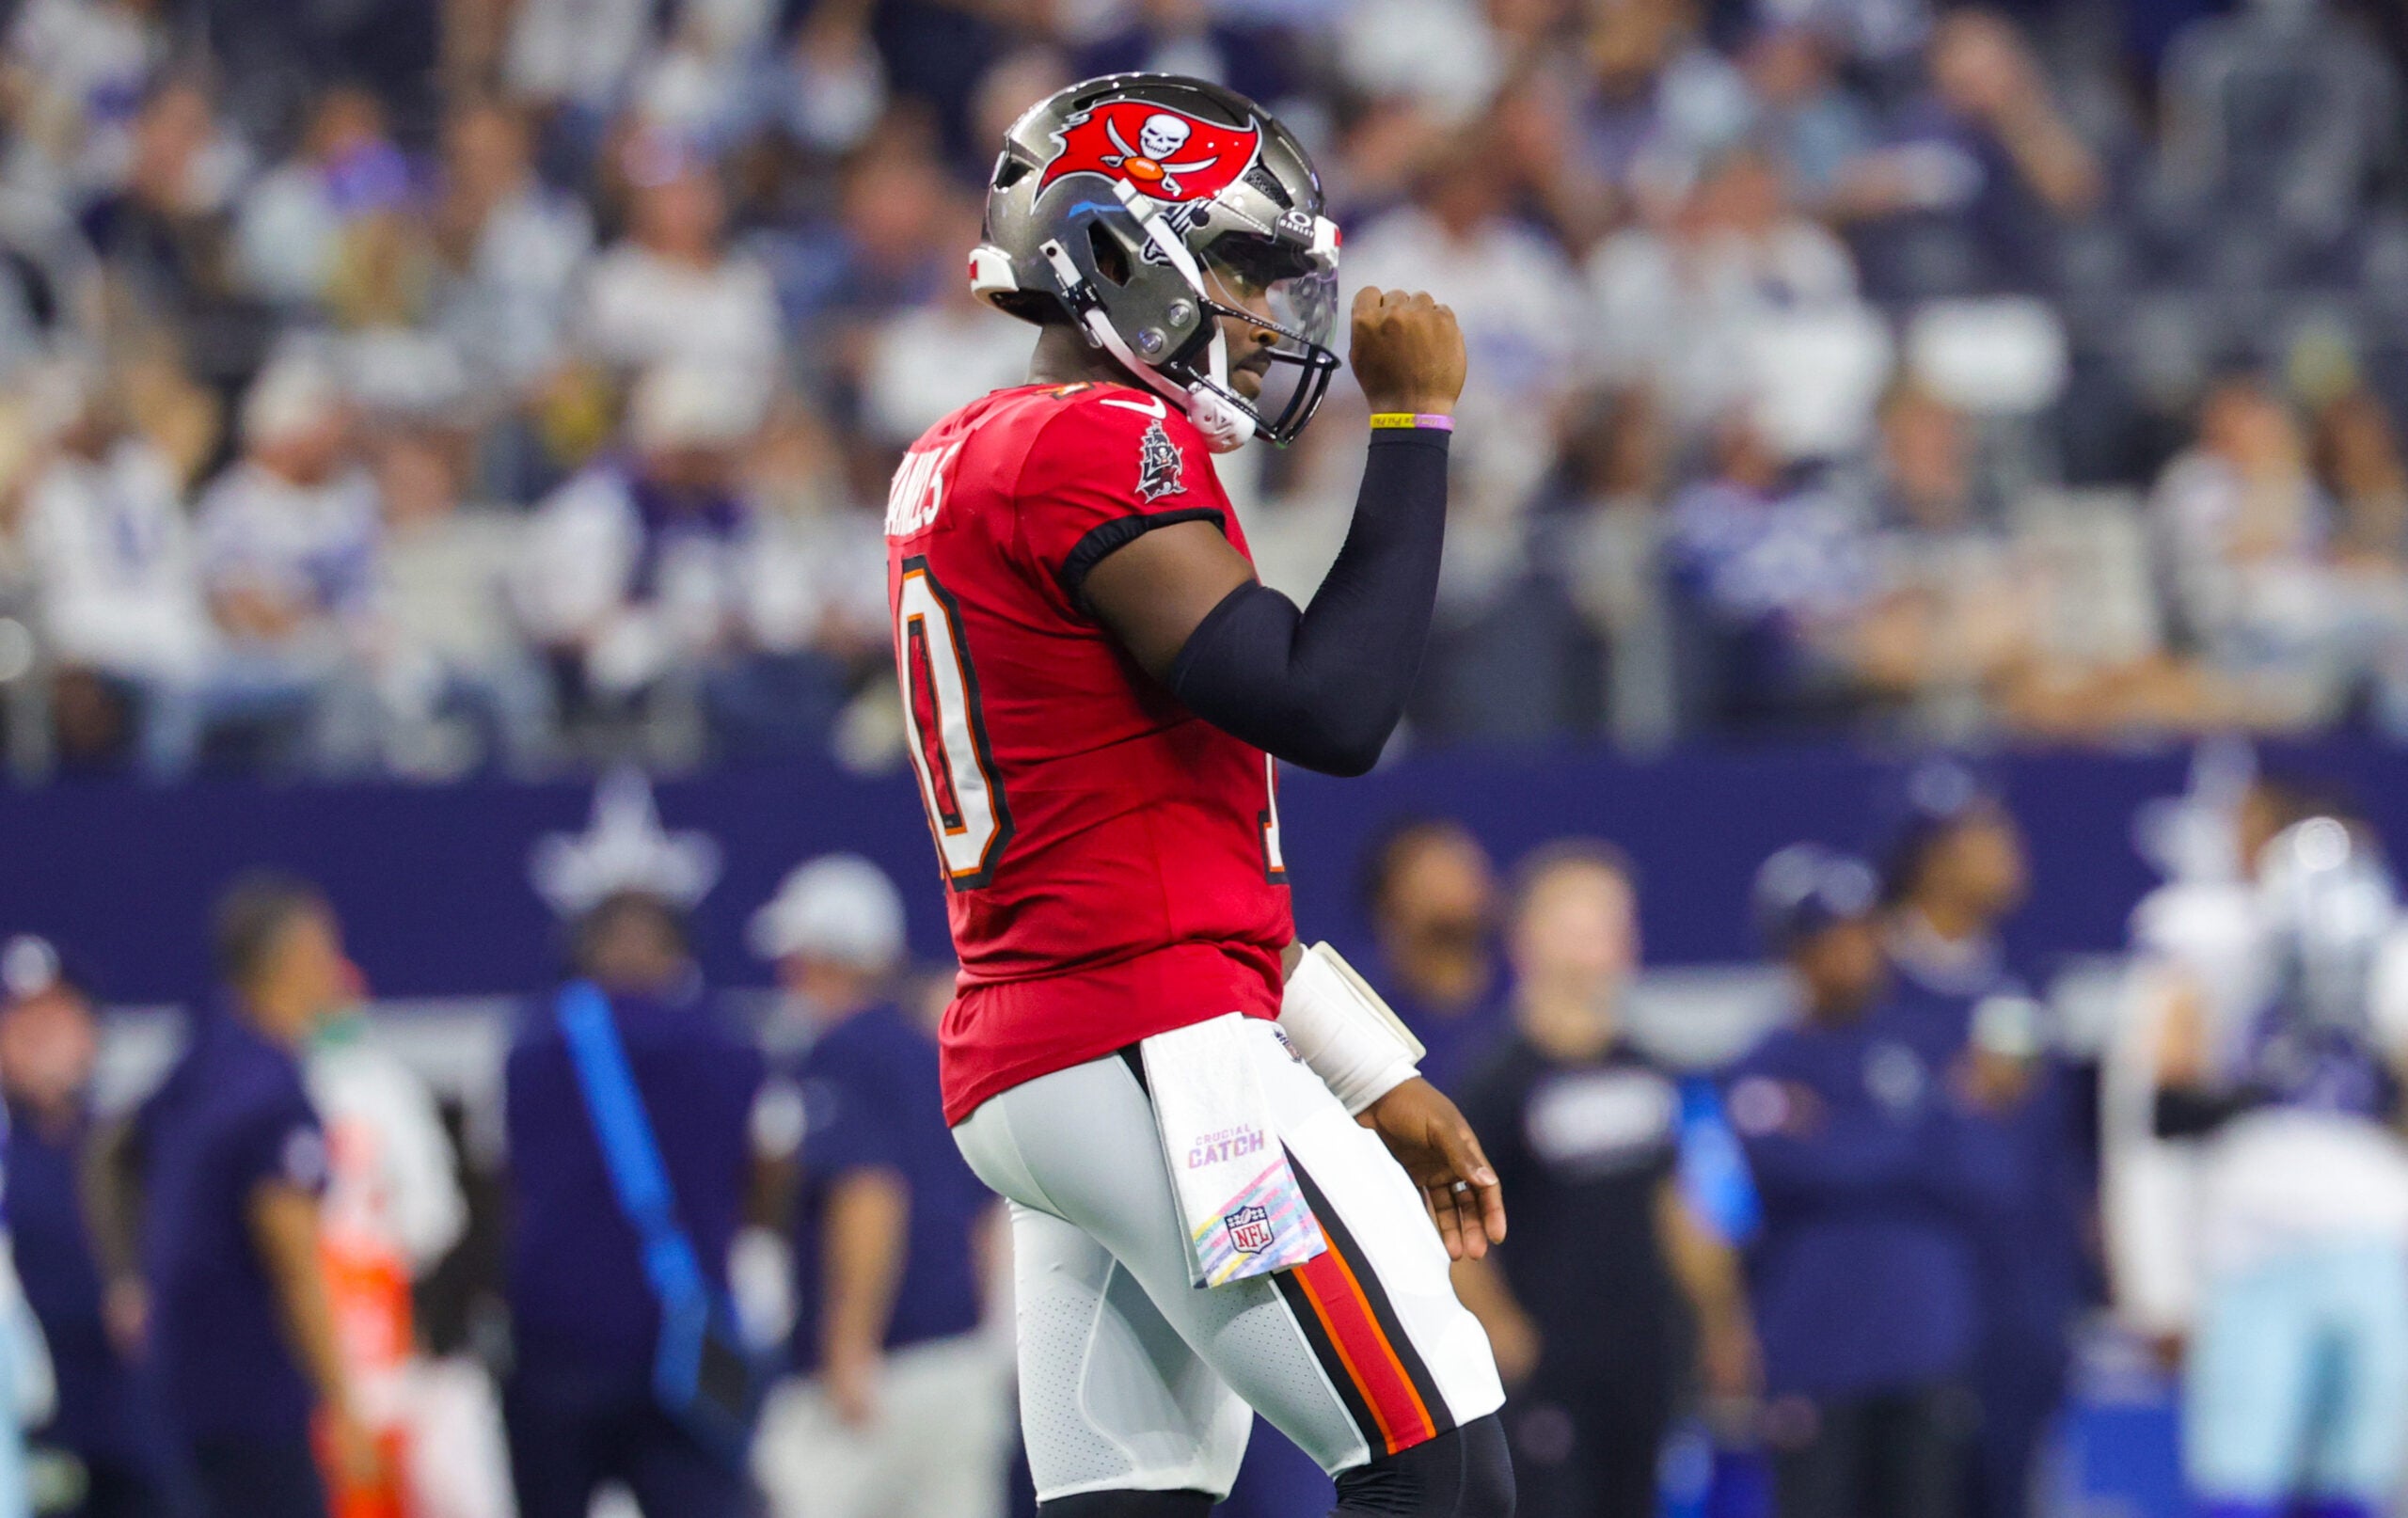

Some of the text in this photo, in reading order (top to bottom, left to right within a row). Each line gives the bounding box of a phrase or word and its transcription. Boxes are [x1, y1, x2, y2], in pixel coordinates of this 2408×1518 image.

[1195, 1123, 1251, 1146] CRUCIAL
[1188, 1129, 1265, 1169] CATCH
[1234, 1223, 1270, 1248] NFL
